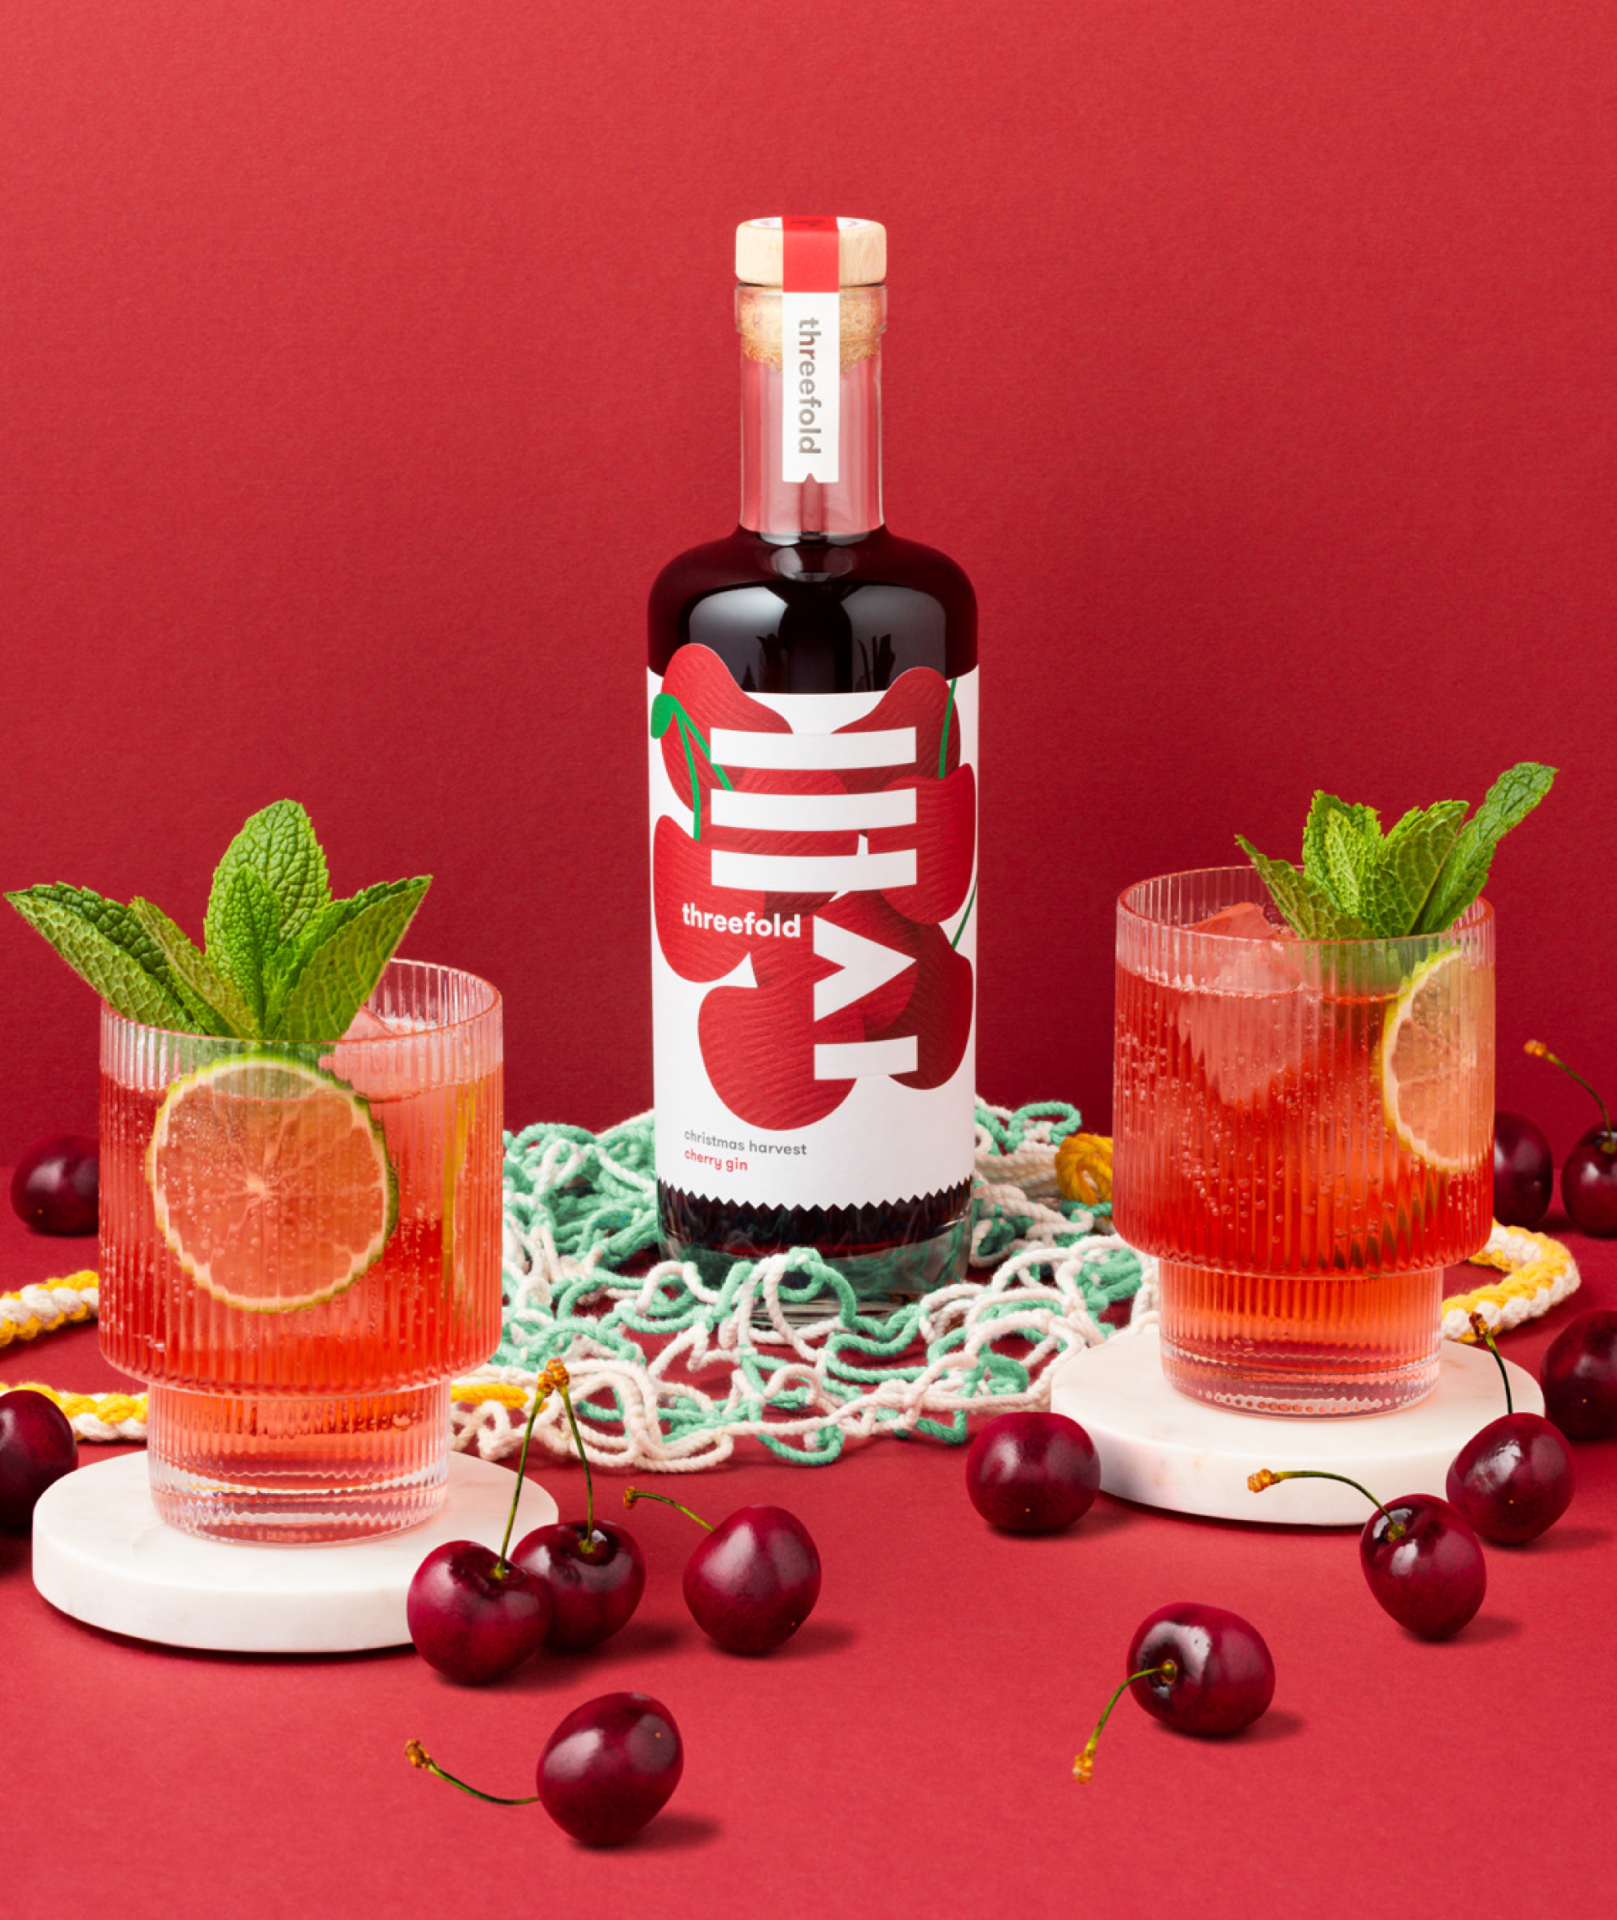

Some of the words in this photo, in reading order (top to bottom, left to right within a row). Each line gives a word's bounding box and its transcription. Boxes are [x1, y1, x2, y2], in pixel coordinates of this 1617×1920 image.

[798, 317, 822, 454] threefold
[682, 902, 801, 938] threefold
[684, 1129, 745, 1151] christmas
[749, 1139, 808, 1156] harvest
[684, 1148, 722, 1171] cherry
[725, 1157, 748, 1173] gin
